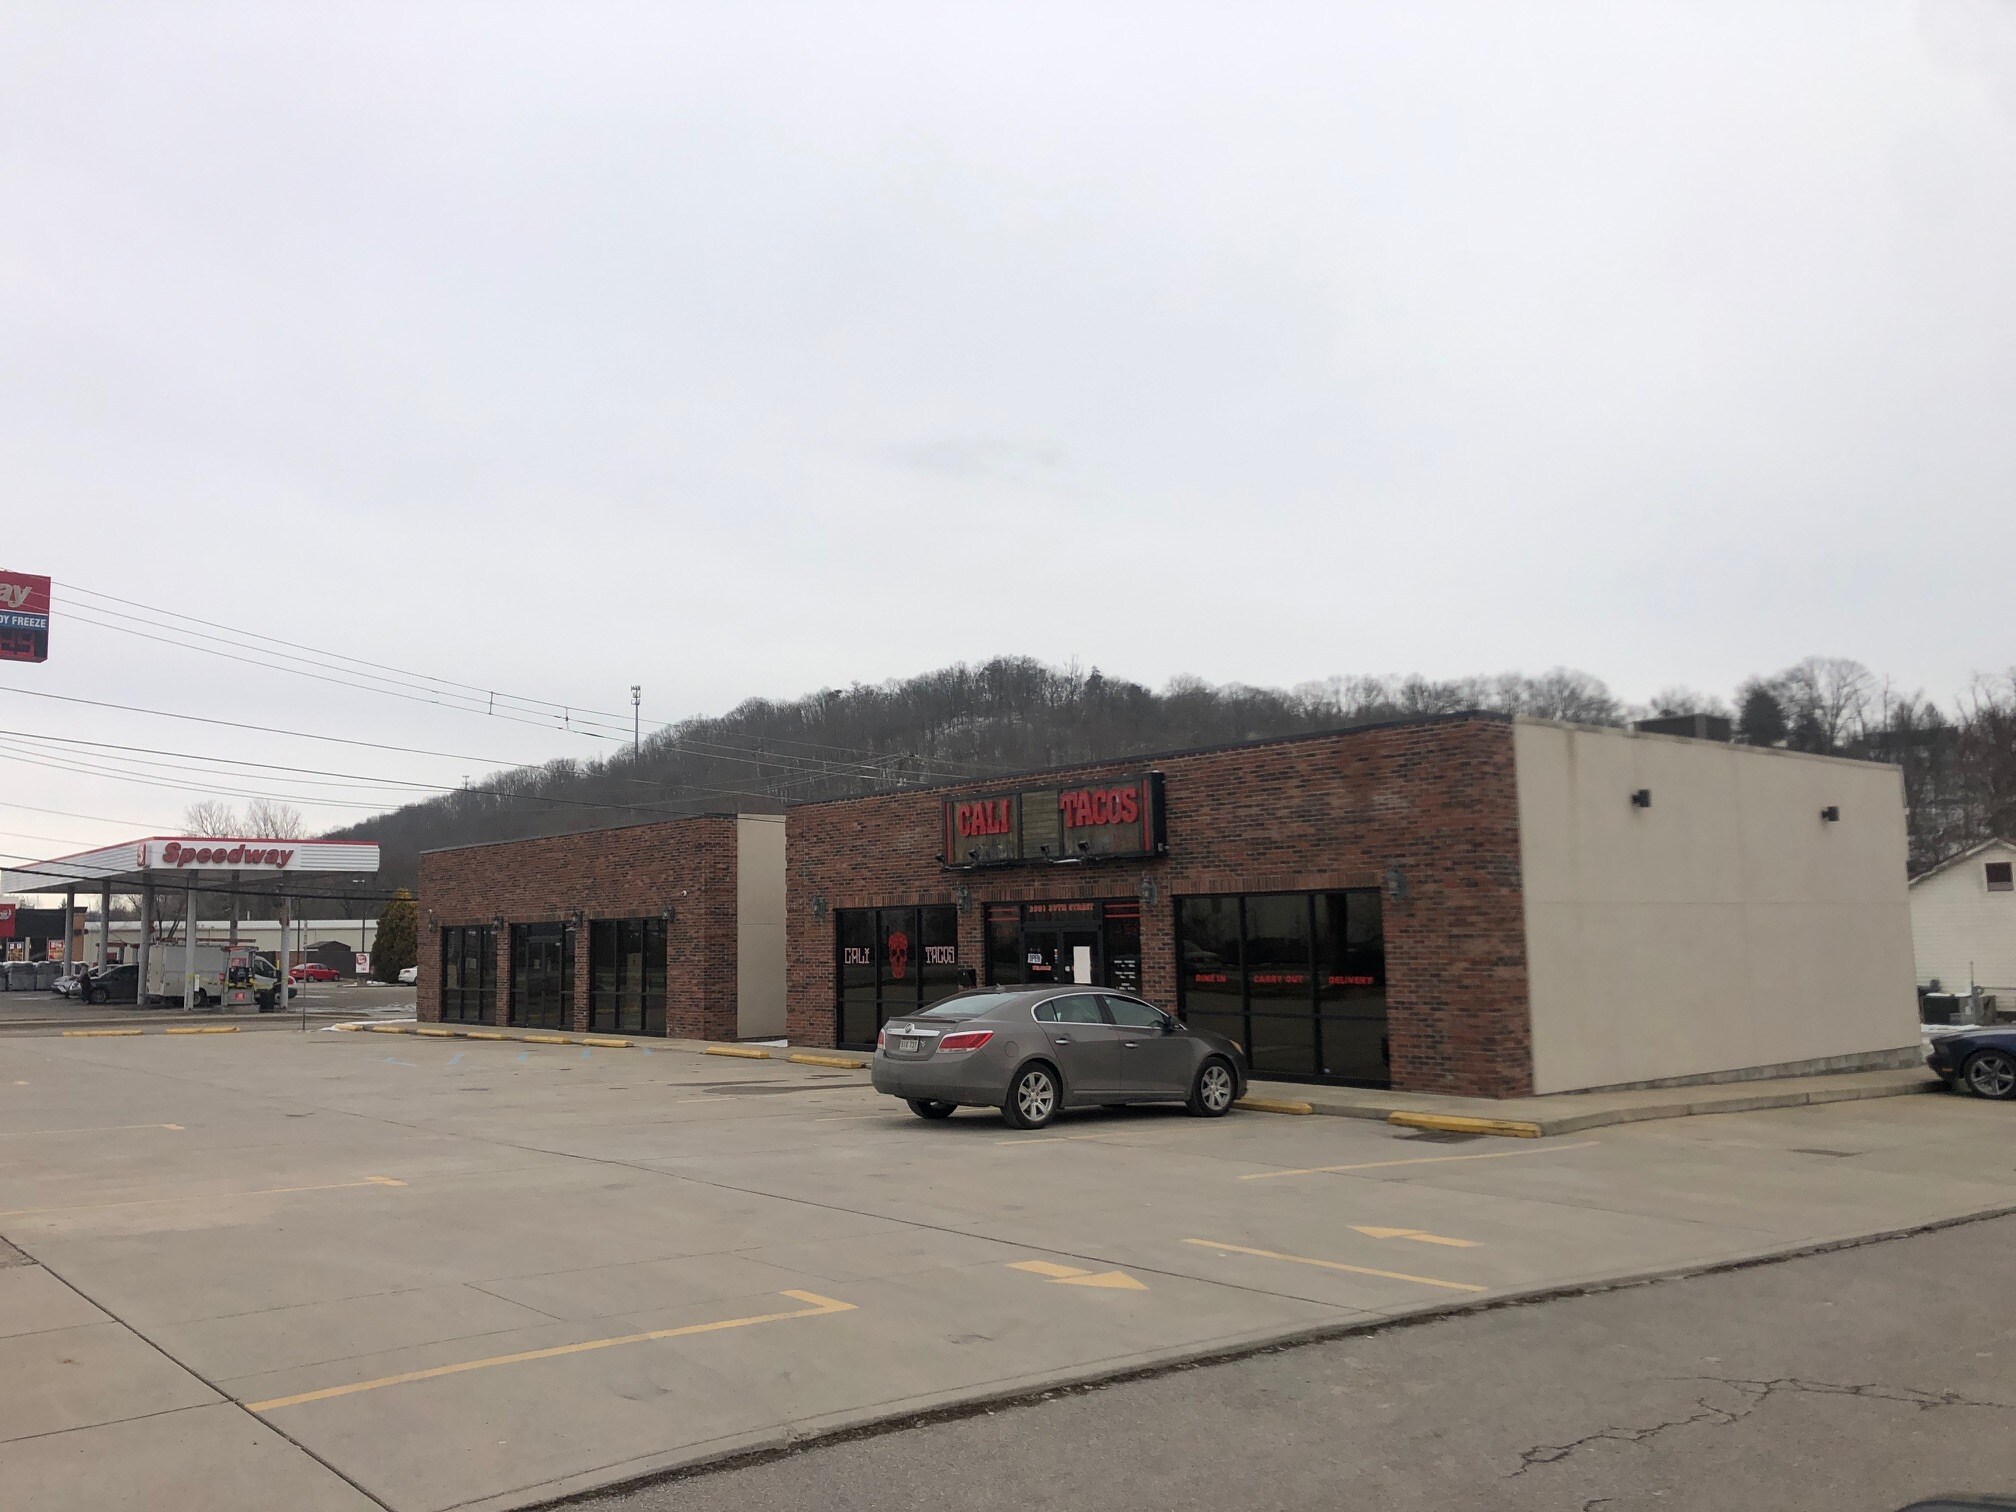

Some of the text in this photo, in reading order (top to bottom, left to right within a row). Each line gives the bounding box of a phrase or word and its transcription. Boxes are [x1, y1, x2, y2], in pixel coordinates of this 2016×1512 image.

[12, 616, 46, 628] FREEZE
[957, 786, 1139, 837] CALI TACOS
[162, 842, 295, 869] Speedway
[844, 946, 955, 964] CALI TACOS
[1253, 974, 1281, 983] CARRY
[1328, 975, 1375, 985] DELIVERY
